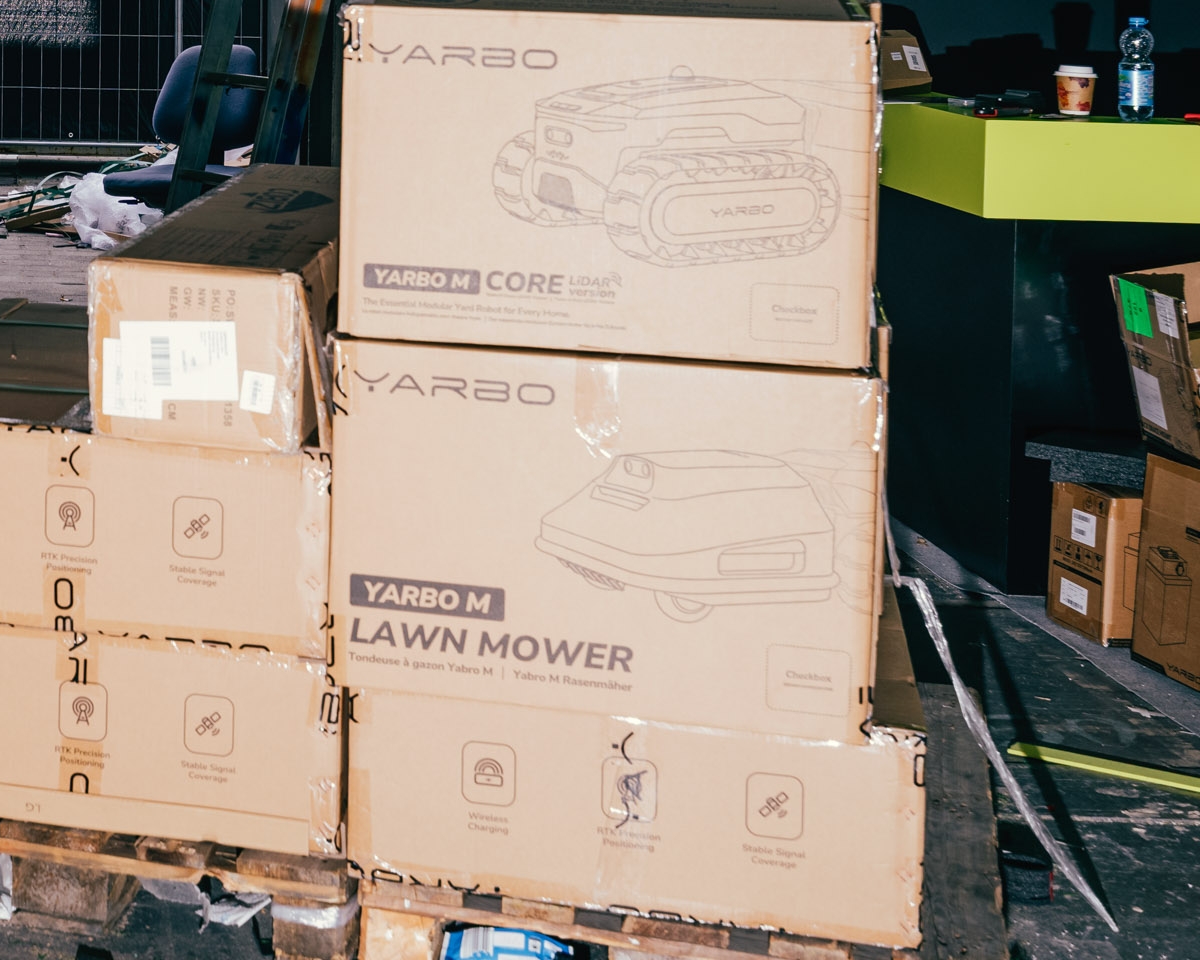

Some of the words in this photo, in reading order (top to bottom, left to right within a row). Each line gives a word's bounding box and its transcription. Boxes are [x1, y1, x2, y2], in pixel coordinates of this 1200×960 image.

[368, 43, 558, 72] YARBO
[710, 204, 775, 219] YARBO
[375, 268, 448, 289] YARBO
[451, 272, 471, 290] M
[486, 270, 565, 295] CORE
[569, 275, 611, 288] LiDAR
[569, 288, 616, 300] version
[362, 297, 378, 307] The
[379, 298, 417, 309] Essential
[418, 300, 453, 311] Modular
[454, 302, 475, 312] Yard
[476, 304, 501, 314] Robot
[503, 305, 516, 315] for
[518, 306, 541, 318] Every
[771, 303, 818, 317] Checkbox
[353, 369, 555, 406] YARBO
[41, 552, 58, 561] RTK
[60, 553, 98, 565] Precision
[46, 562, 92, 575] Positioning
[169, 564, 197, 575] Stable
[199, 566, 226, 579] Signal
[177, 575, 218, 588] Coverage
[364, 580, 460, 611] YARBO
[466, 591, 491, 614] M
[350, 617, 468, 655] LAWN
[478, 630, 634, 674] MOWER
[348, 651, 400, 667] Tondeuse
[403, 656, 410, 667] à
[412, 660, 445, 672] gazon
[447, 662, 480, 676] Yabro
[482, 665, 494, 677] M
[513, 669, 547, 683] Yabro
[548, 673, 560, 685] M
[562, 674, 634, 693] Rasenmäher
[785, 669, 833, 684] Checkbox
[54, 745, 72, 755] RTK
[73, 747, 111, 759] Precision
[59, 755, 105, 770] Positioning
[181, 759, 208, 771] Stable
[210, 763, 236, 775] Signal
[188, 771, 228, 784] Coverage
[468, 811, 509, 824] Wireless
[467, 822, 509, 836] Charging
[597, 826, 617, 836] RTK
[618, 828, 662, 842] Precision
[602, 838, 655, 853] Positioning
[742, 842, 774, 855] Stable
[775, 847, 806, 859] Signal
[751, 855, 797, 869] Coverage
